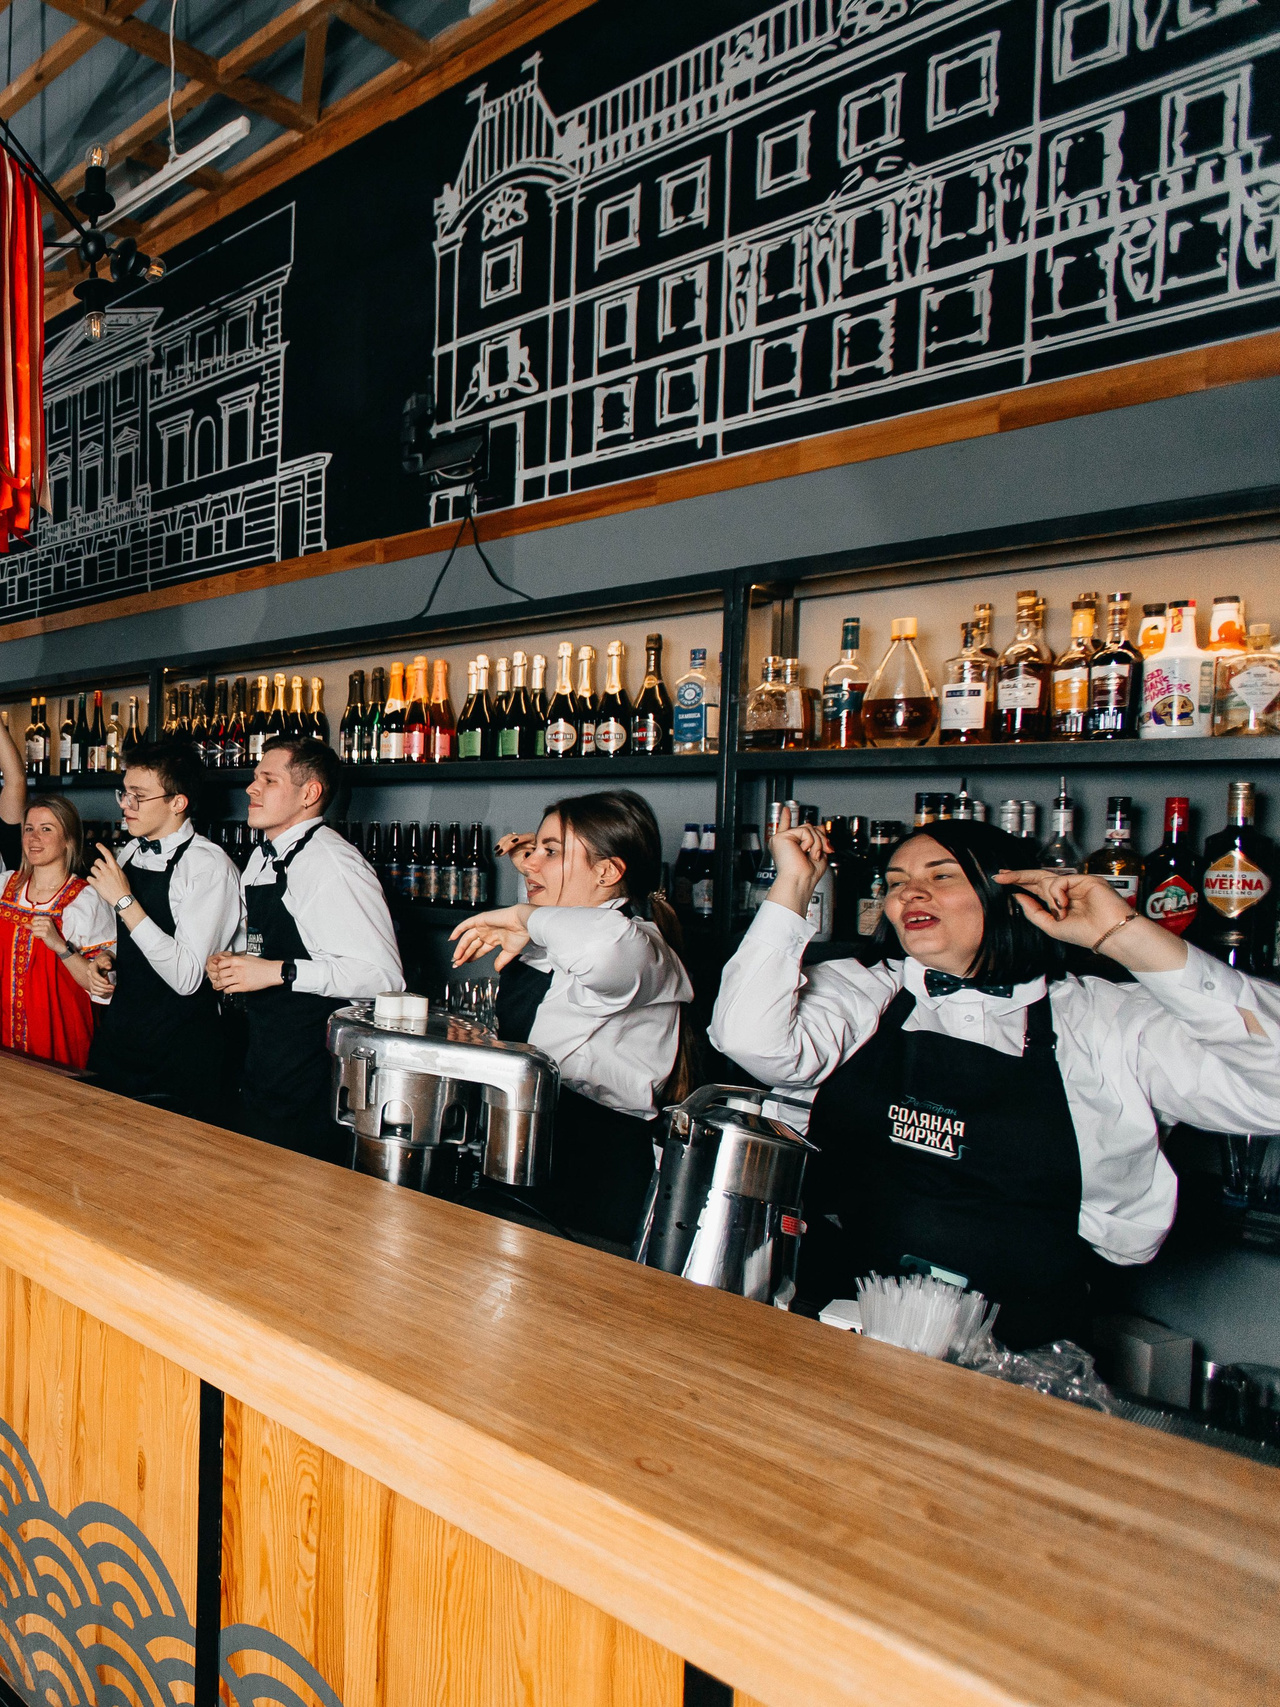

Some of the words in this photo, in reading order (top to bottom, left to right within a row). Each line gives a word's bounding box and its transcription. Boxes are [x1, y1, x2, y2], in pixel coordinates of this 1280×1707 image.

[1144, 683, 1191, 703] FINGERS
[1204, 878, 1264, 891] AVERNA
[1145, 890, 1199, 919] CYNAR
[888, 1104, 965, 1137] СОЛЯНАЯ
[892, 1121, 954, 1152] БИРЖА
